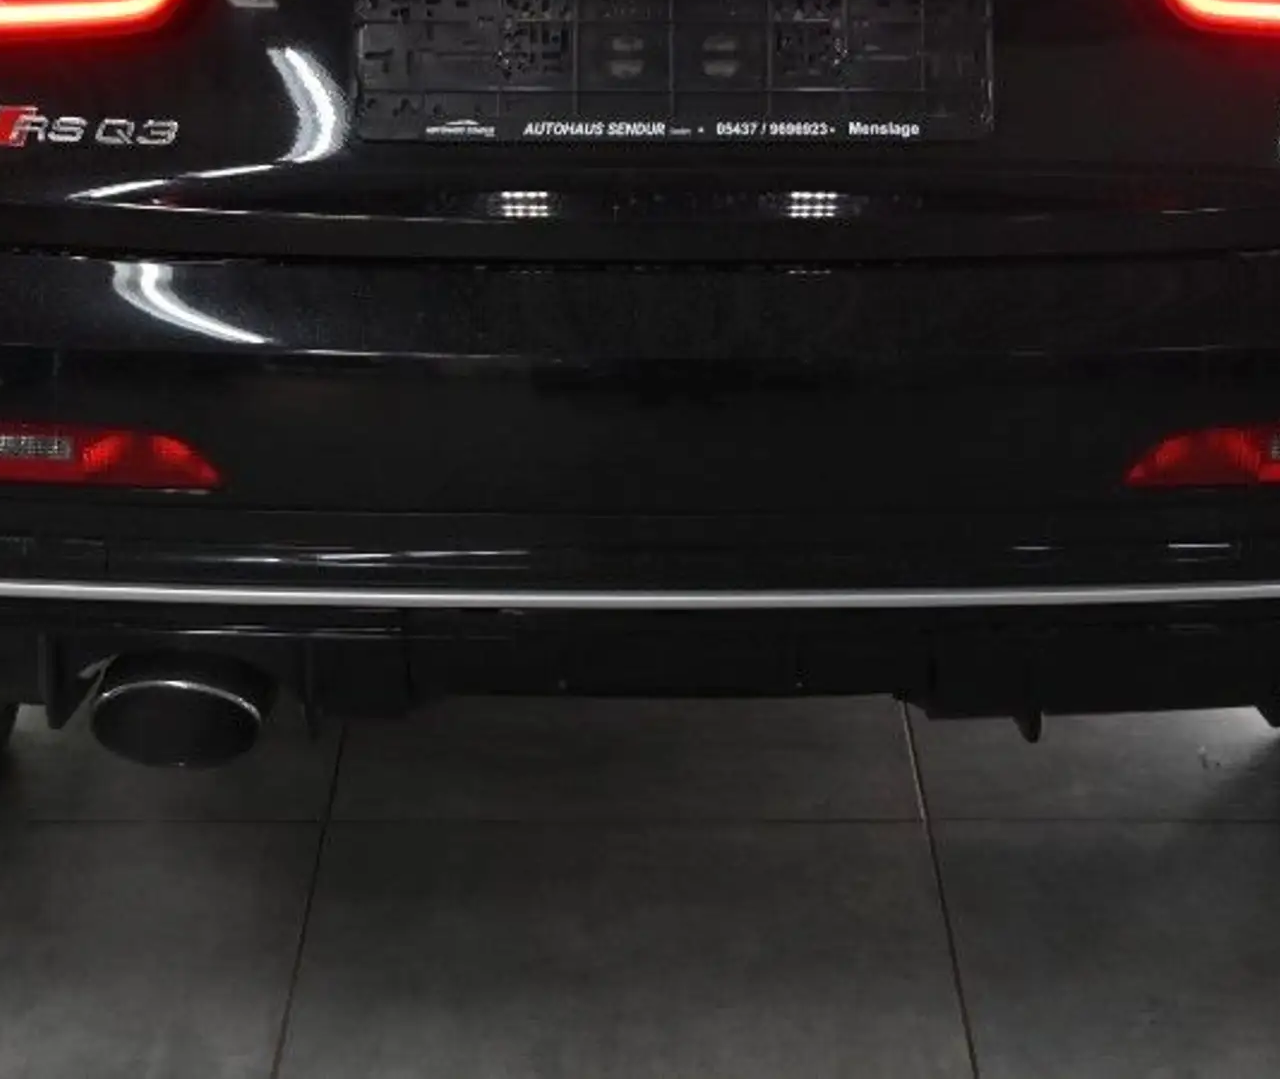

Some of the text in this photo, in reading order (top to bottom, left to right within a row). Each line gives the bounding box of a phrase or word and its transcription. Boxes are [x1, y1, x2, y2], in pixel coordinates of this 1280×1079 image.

[95, 118, 179, 145] Q3
[523, 122, 604, 136] AUTOHAUS
[607, 122, 666, 136] SENDUR
[716, 122, 757, 136] 05437
[848, 122, 920, 138] Menslage
